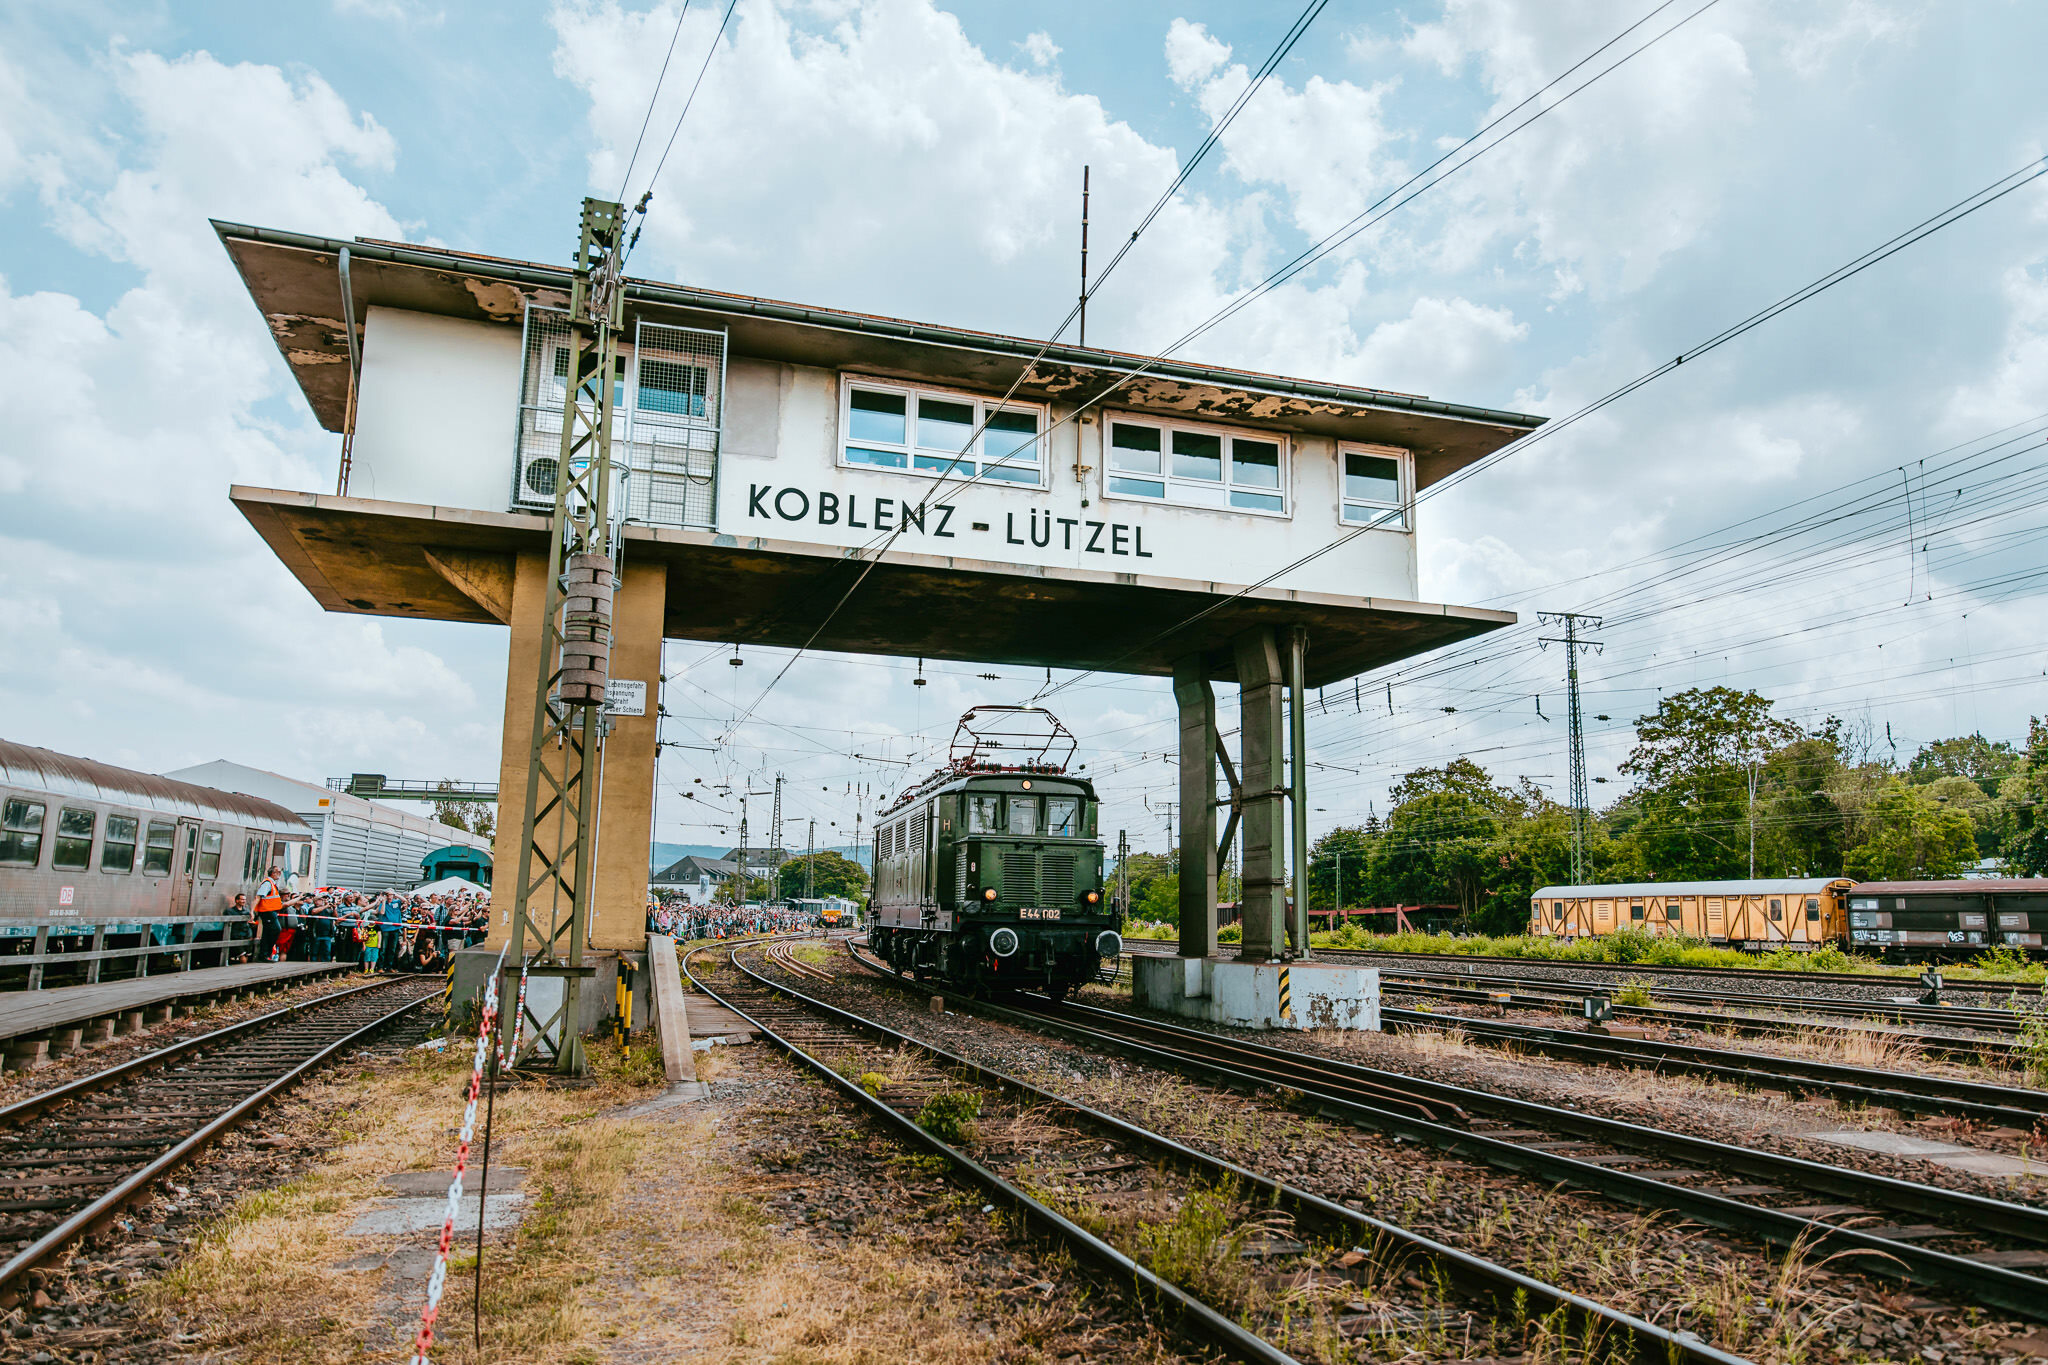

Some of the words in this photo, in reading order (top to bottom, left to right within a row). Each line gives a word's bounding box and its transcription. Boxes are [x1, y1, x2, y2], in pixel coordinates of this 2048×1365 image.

[749, 483, 956, 538] KOBLENZ
[1006, 507, 1153, 558] LÜTZEL
[60, 887, 73, 904] DB
[1020, 908, 1040, 919] E44
